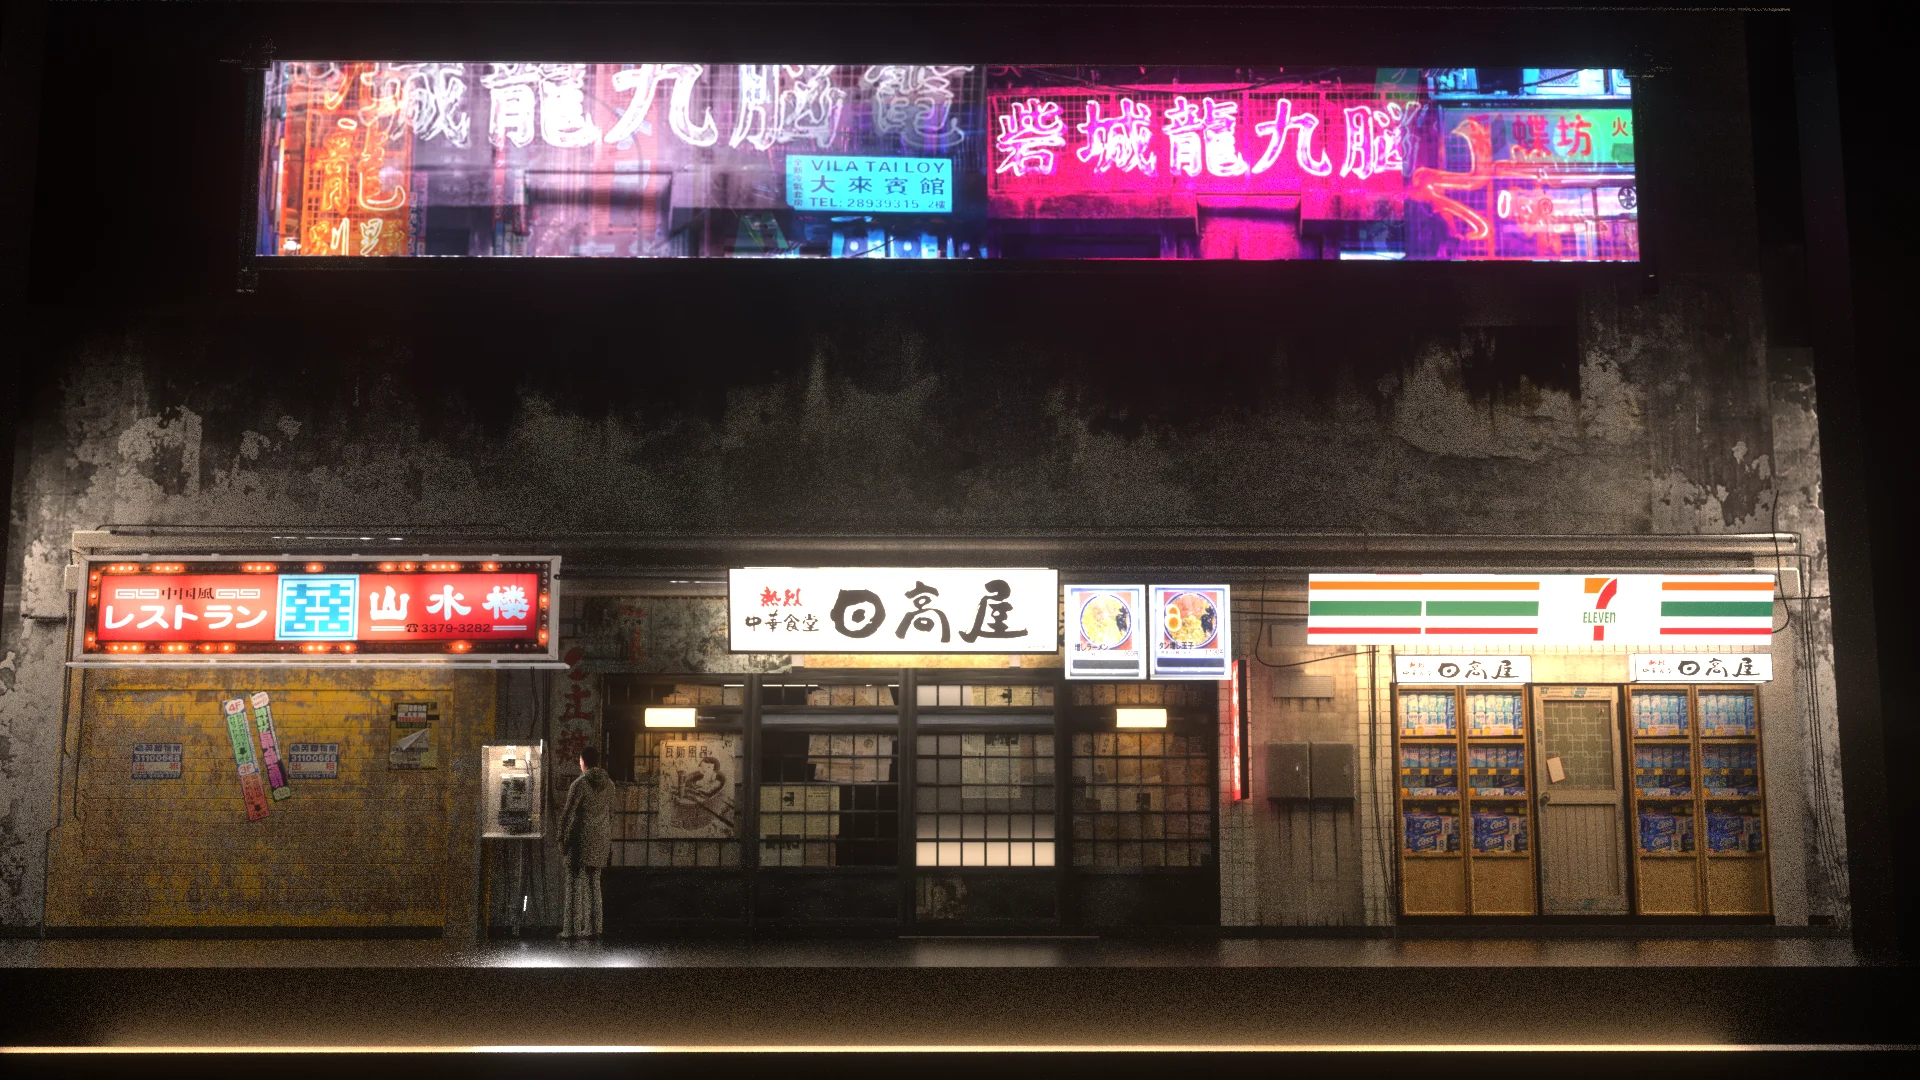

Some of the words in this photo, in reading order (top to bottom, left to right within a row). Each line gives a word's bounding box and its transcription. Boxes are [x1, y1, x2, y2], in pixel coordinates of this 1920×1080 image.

[810, 159, 859, 172] VILA
[865, 160, 898, 173] TAI
[904, 162, 945, 174] LOY
[810, 175, 945, 196] 大來賓館
[809, 197, 843, 208] TEL:
[847, 198, 919, 209] 28939315
[369, 584, 530, 621] 山水楼
[760, 586, 803, 607] 熱烈
[105, 604, 268, 630] レストラン
[744, 609, 820, 632] 中華食堂
[830, 579, 1029, 643] 日高屋
[1437, 659, 1520, 680] 日高屋
[1677, 657, 1760, 678] 日高屋
[228, 702, 243, 712] 4F
